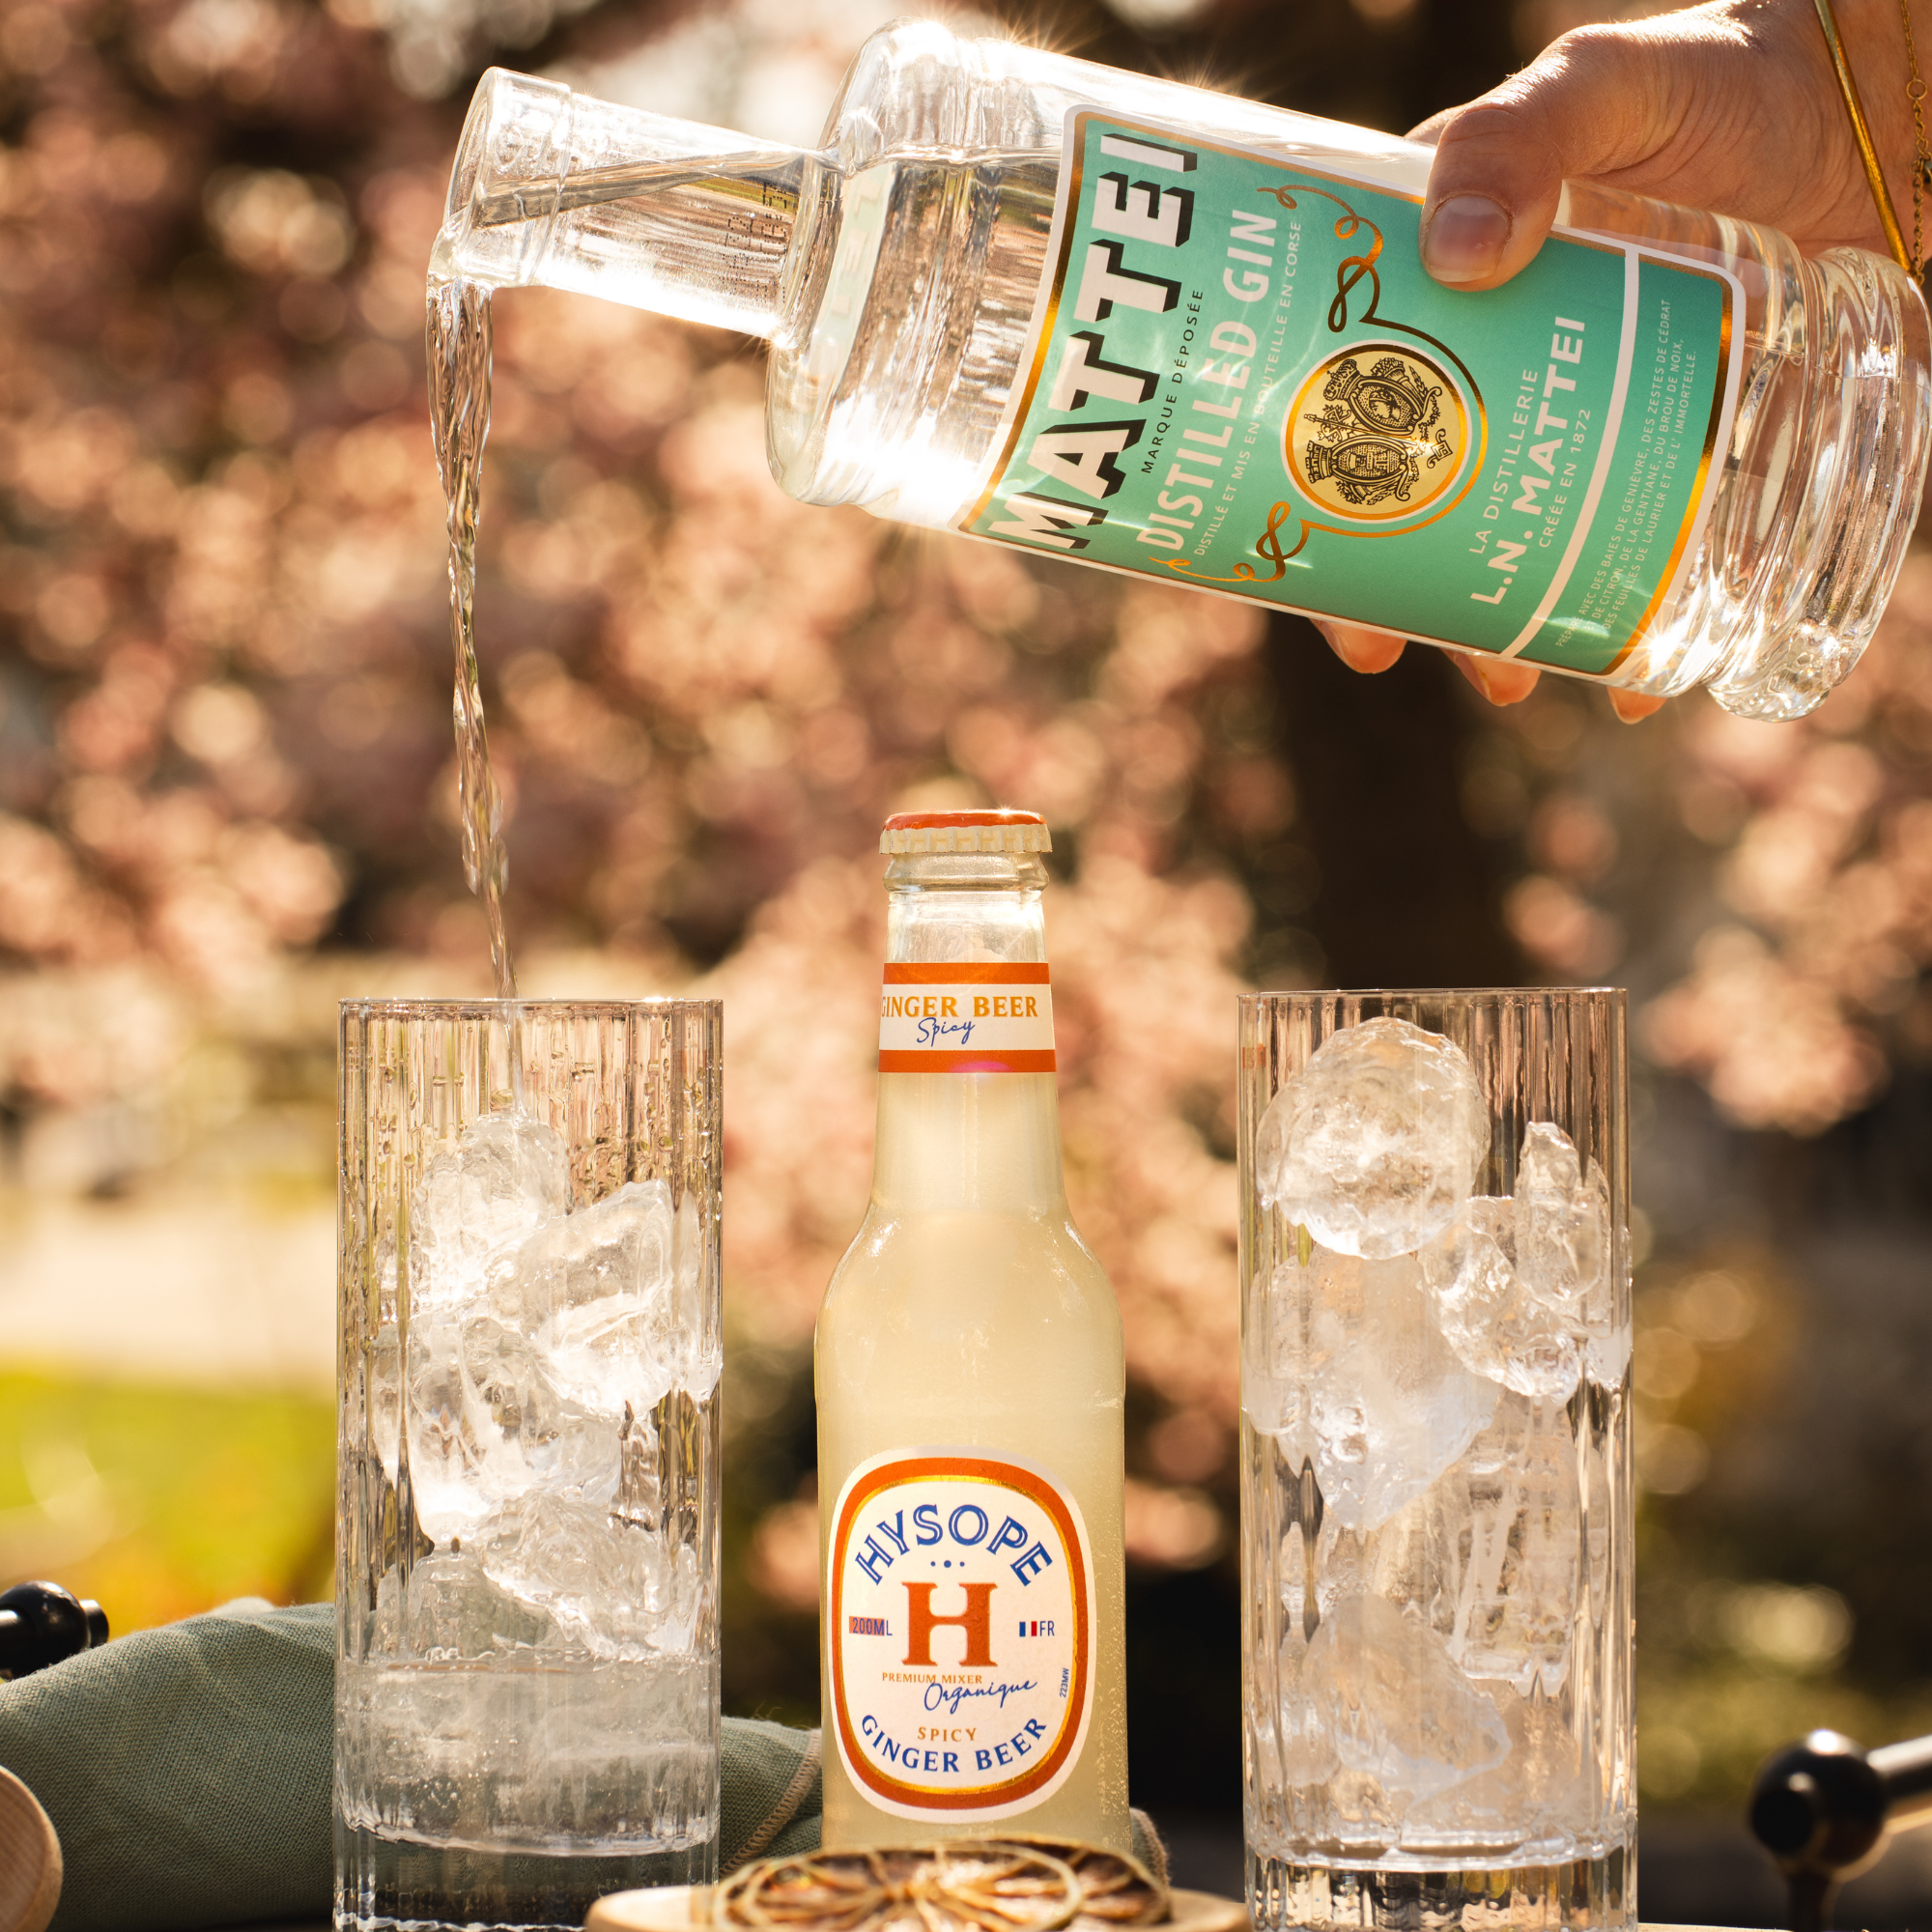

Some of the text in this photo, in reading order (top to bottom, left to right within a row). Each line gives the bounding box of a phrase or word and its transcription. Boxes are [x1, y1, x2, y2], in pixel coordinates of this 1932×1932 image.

[1658, 299, 1671, 344] CÉDRAT
[987, 132, 1198, 550] MATTEI
[1656, 348, 1667, 363] DE
[1671, 339, 1685, 372] NOIX,
[1136, 210, 1277, 551] DISTILLED GIN
[1141, 290, 1204, 474] MARQUE DÉPOSÉE
[1194, 221, 1301, 556] DISTILLÉ ET MIS EN BOUTEILLE EN CORSE
[1648, 367, 1664, 413] ZESTES
[1666, 377, 1678, 392] DE
[1674, 351, 1696, 434] IMMORTELLE.
[1641, 418, 1655, 442] DES
[1660, 397, 1674, 432] BROU
[1468, 369, 1538, 554] LA DISTILLERIE
[1469, 316, 1585, 605] L.N. MATTEI
[1653, 437, 1666, 455] DU
[1665, 454, 1678, 469] DE
[1539, 410, 1591, 548] CRÉÉE EN 1872
[1622, 448, 1650, 512] GENIÈVRE,
[1633, 459, 1662, 525] GENTIANE,
[1660, 473, 1672, 489] ET
[1615, 516, 1629, 531] DE
[1642, 492, 1666, 543] LAURIER
[1601, 534, 1621, 567] BAIES
[1628, 528, 1639, 543] LA
[1619, 546, 1634, 561] DE
[1635, 547, 1648, 561] DE
[1593, 570, 1606, 591] DES
[1600, 565, 1628, 605] CITRON,
[1612, 564, 1641, 611] FEUILLES
[1578, 591, 1596, 615] AVEC
[1591, 608, 1605, 619] DE
[1603, 611, 1618, 630] DES
[881, 996, 1038, 1018] GINGER BEER
[917, 1016, 976, 1047] Spicy
[855, 1503, 1053, 1586] HYSOPE
[851, 1617, 893, 1636] 200ML
[901, 1581, 998, 1667] H
[1039, 1621, 1055, 1636] FR
[882, 1672, 982, 1685] PREMIUM MIXER
[923, 1679, 1037, 1715] Organique
[861, 1714, 1047, 1773] GINGER BEER
[917, 1726, 978, 1742] SPICY
